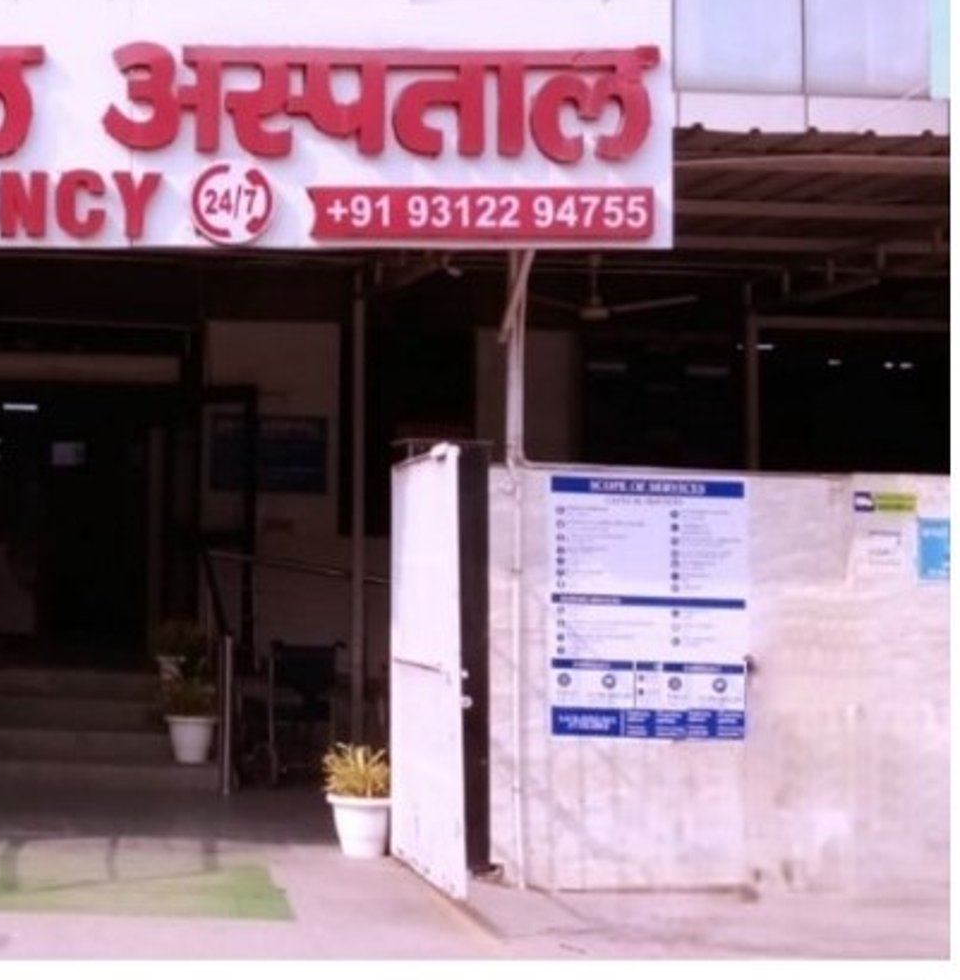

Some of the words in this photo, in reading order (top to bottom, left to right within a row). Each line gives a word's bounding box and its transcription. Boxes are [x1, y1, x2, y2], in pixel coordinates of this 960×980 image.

[101, 41, 660, 165] अस्पताल
[203, 179, 258, 219] 24/7
[326, 195, 390, 227] +91
[407, 195, 521, 228] 93122
[532, 195, 648, 228] 94755
